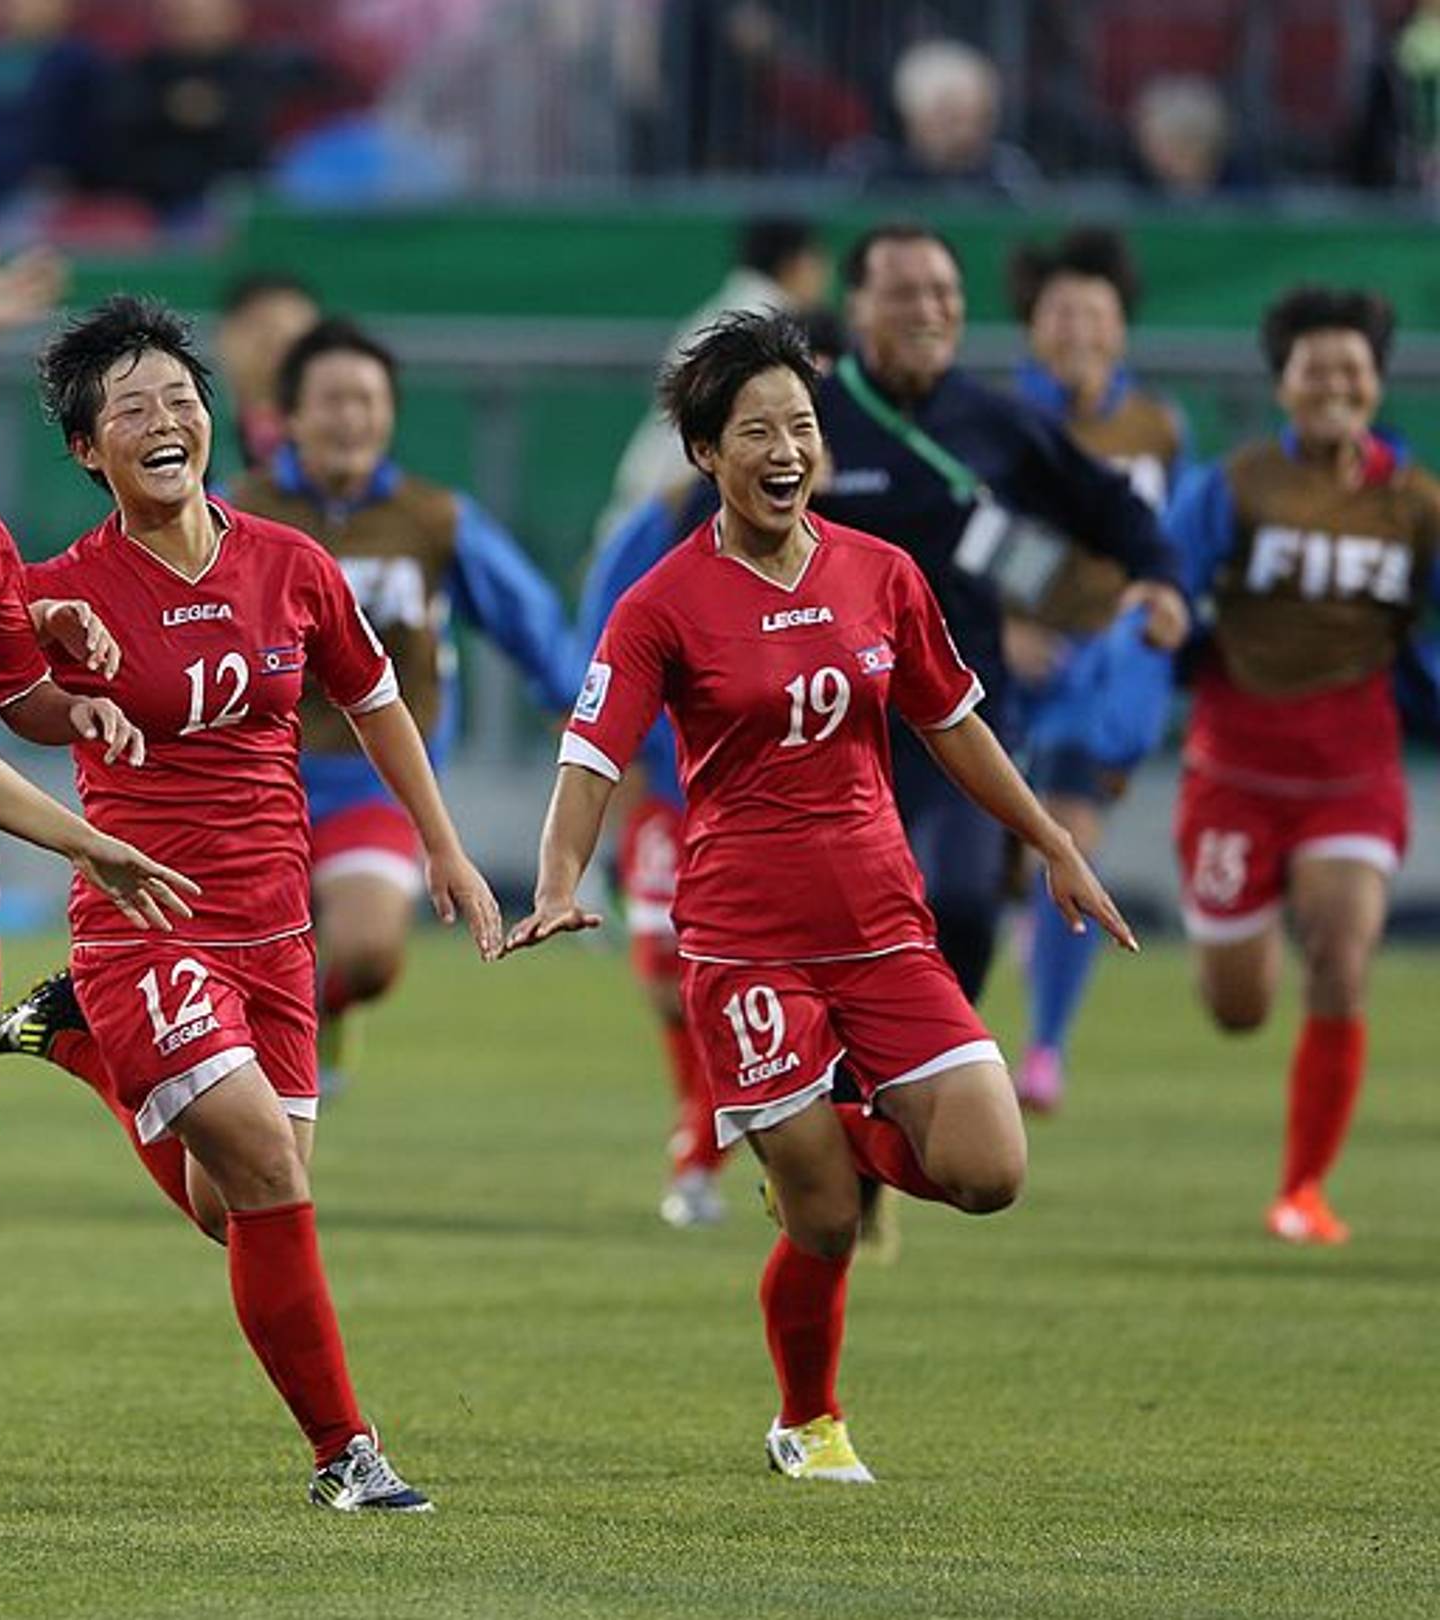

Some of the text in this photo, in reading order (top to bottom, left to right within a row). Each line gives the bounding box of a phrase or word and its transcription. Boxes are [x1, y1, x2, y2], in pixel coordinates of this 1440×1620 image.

[1247, 528, 1412, 604] FIFA
[162, 603, 233, 627] LEGEA
[761, 606, 834, 632] LEGEA
[178, 652, 250, 736] 12
[778, 666, 852, 748] 19
[136, 958, 213, 1045] 12
[160, 1015, 221, 1056] LEGEA
[722, 985, 788, 1070] 19
[737, 1051, 801, 1088] LEGEA
